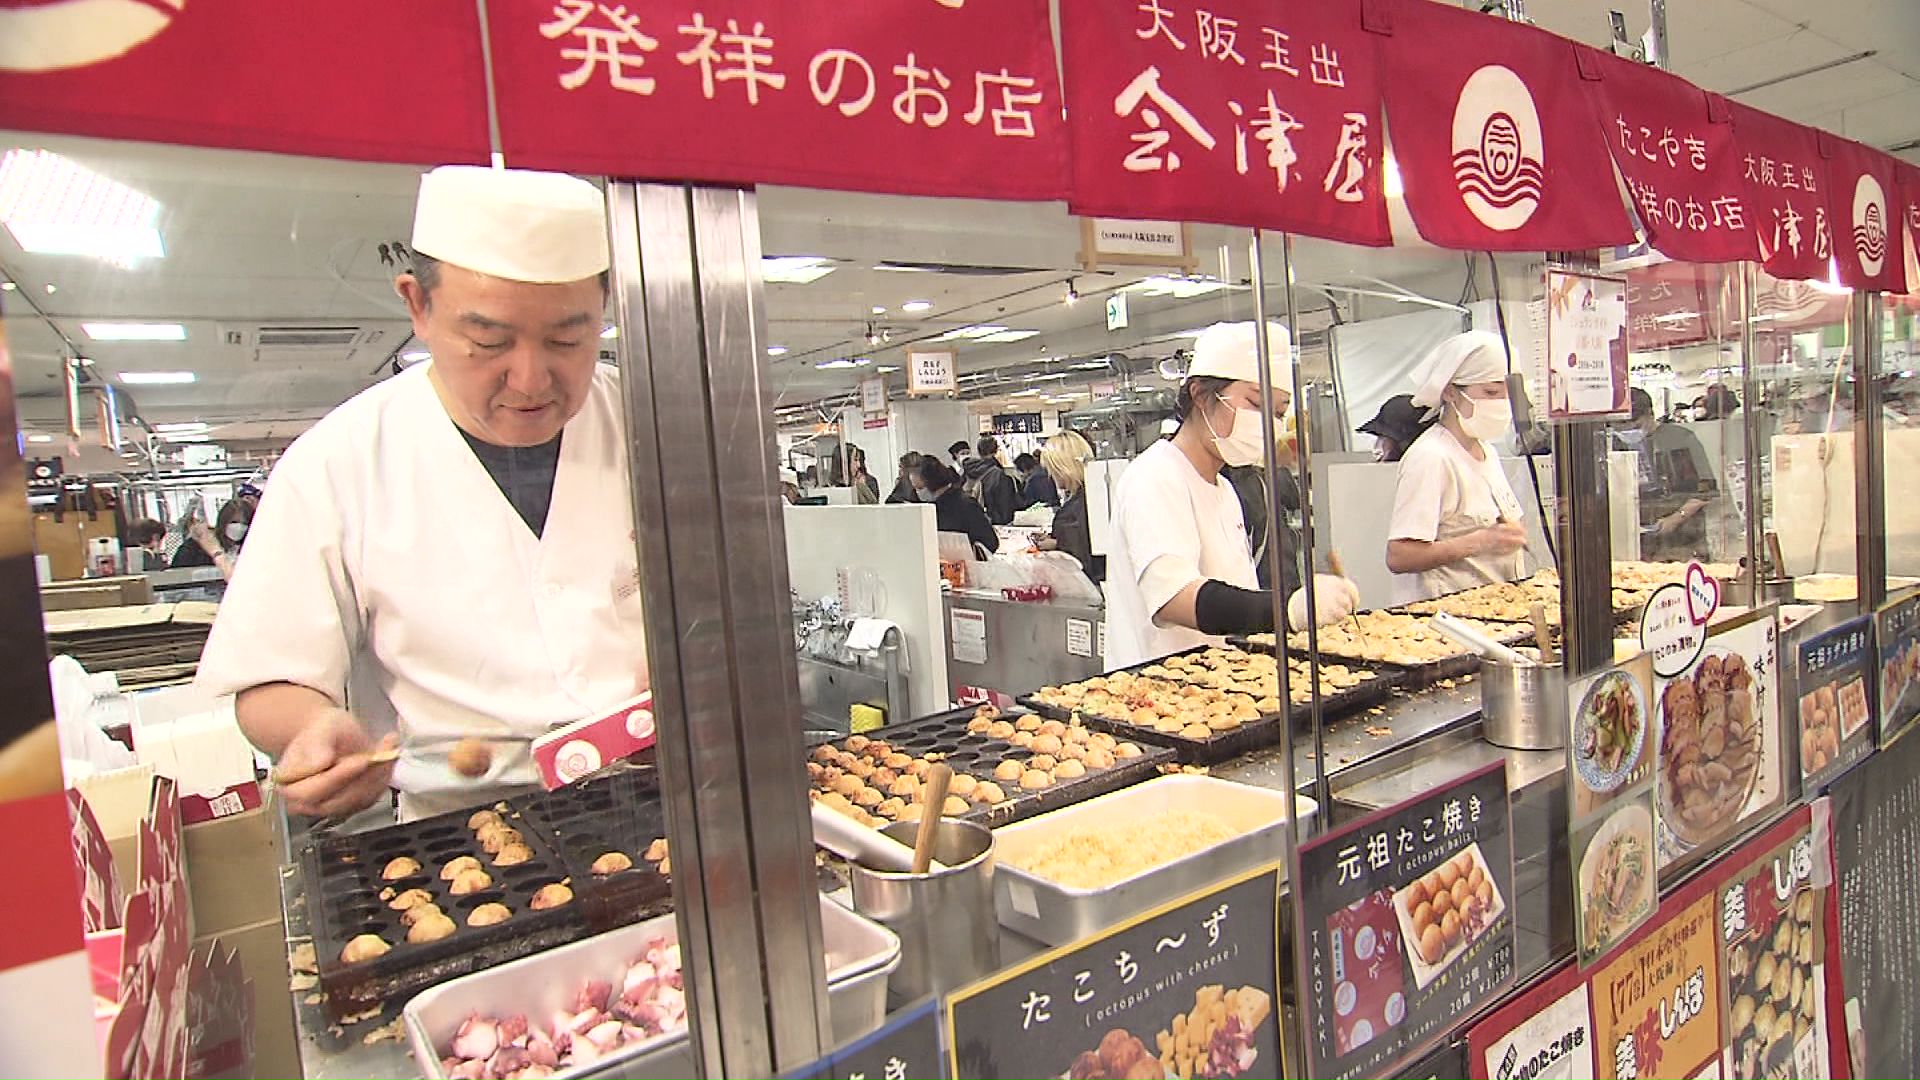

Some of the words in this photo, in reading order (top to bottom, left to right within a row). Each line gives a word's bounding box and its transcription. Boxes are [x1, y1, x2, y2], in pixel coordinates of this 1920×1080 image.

[540, 0, 1043, 138] 発祥のお店
[1136, 0, 1345, 88] 大阪玉出
[1114, 65, 1372, 203] 会津屋
[1615, 113, 1707, 170] たこやき
[1743, 152, 1817, 193] 大阪玉出
[1625, 176, 1745, 231] 祥のお店
[1336, 794, 1482, 886] 元祖たこ焼き
[1154, 970, 1184, 1001] with
[1310, 928, 1328, 1058] TAKOYAKI
[1615, 964, 1705, 1080] 美味しんぼ
